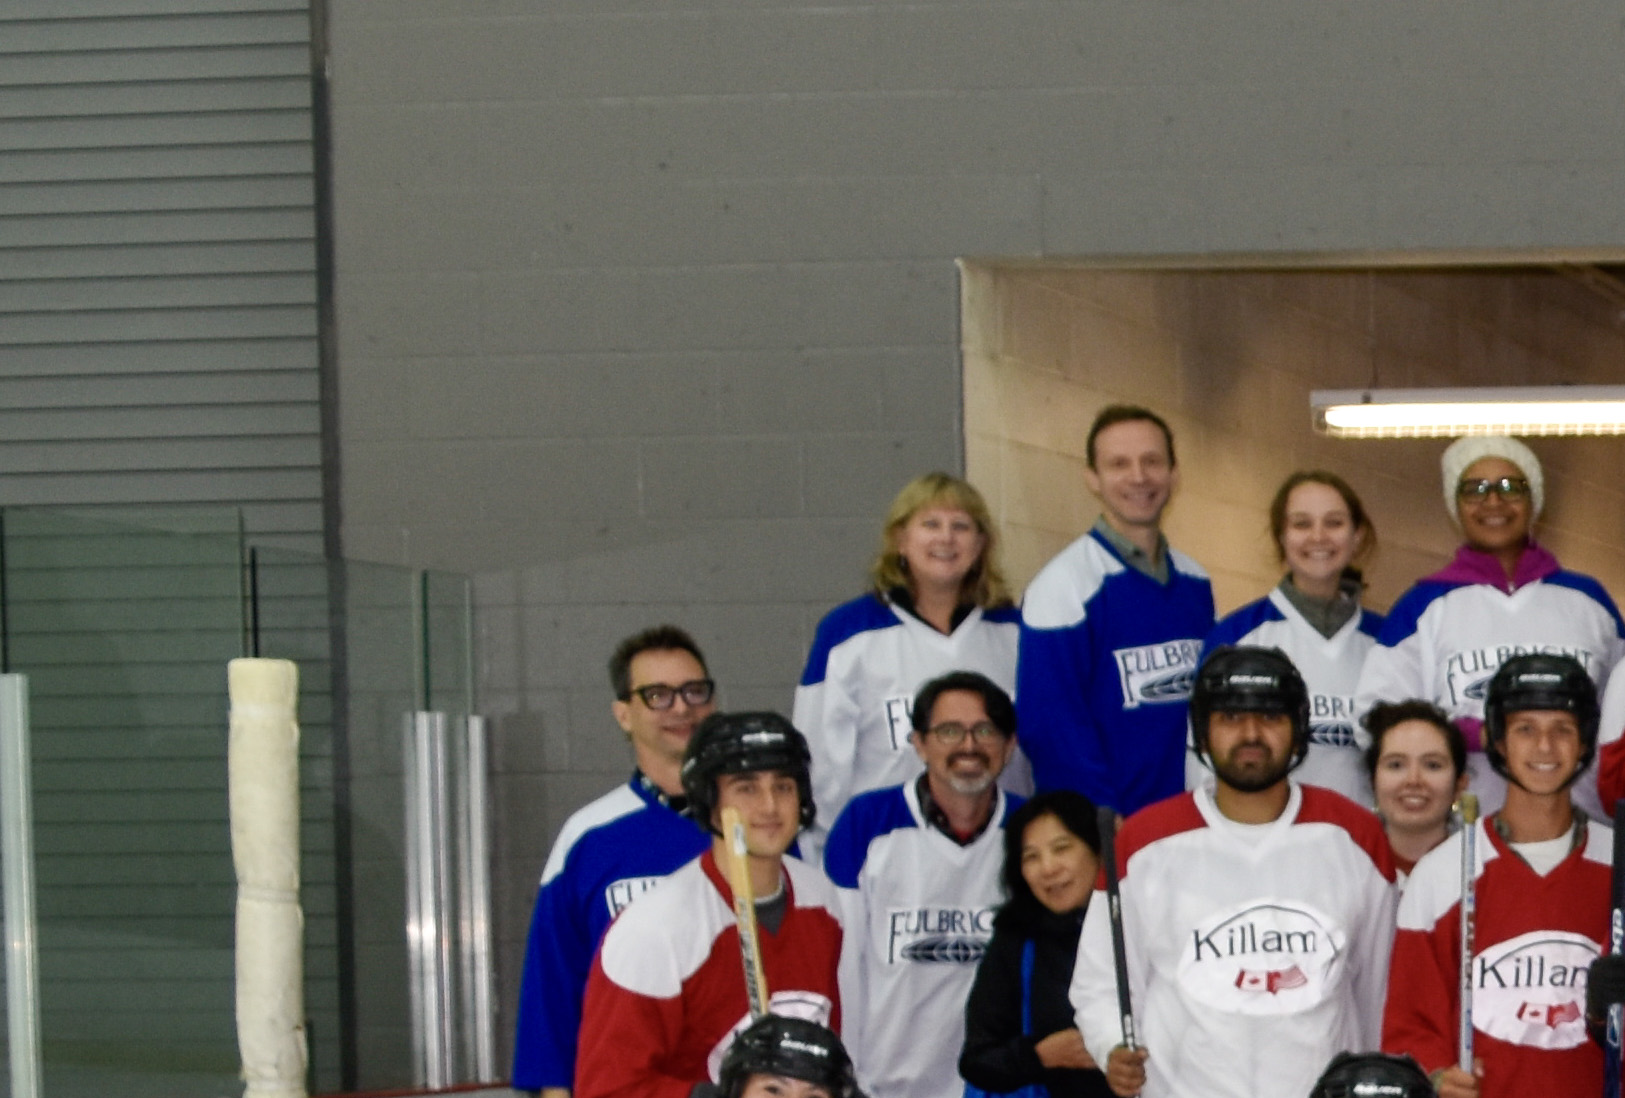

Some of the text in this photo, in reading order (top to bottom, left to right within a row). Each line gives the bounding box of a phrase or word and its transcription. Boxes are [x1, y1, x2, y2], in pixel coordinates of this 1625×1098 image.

[1120, 644, 1203, 706] FULBRI
[889, 911, 998, 963] FULBRIG
[1193, 922, 1317, 962] Killam
